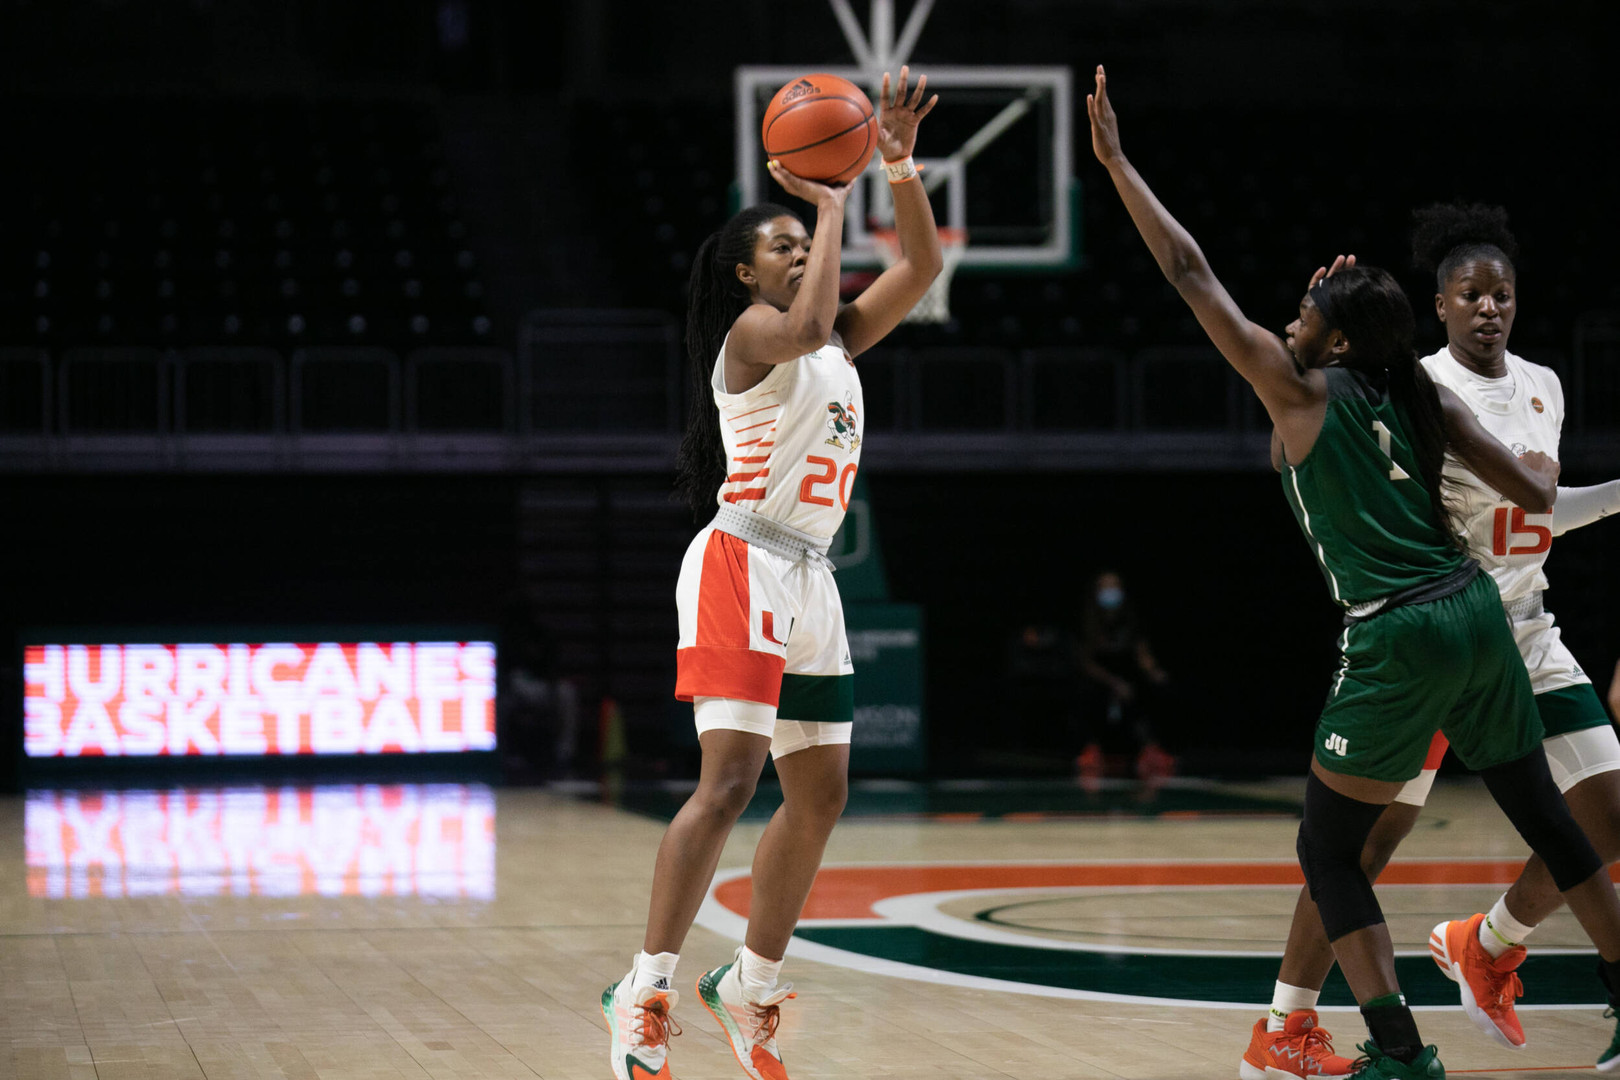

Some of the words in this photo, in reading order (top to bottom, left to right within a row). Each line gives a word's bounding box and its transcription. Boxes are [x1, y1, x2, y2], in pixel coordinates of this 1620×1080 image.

[782, 86, 821, 105] adidas
[1372, 420, 1410, 480] 1
[800, 455, 858, 512] 20
[1493, 507, 1553, 556] 15
[25, 642, 496, 700] HURRICANES
[25, 698, 496, 757] BASKETBALL
[1325, 732, 1349, 757] JU
